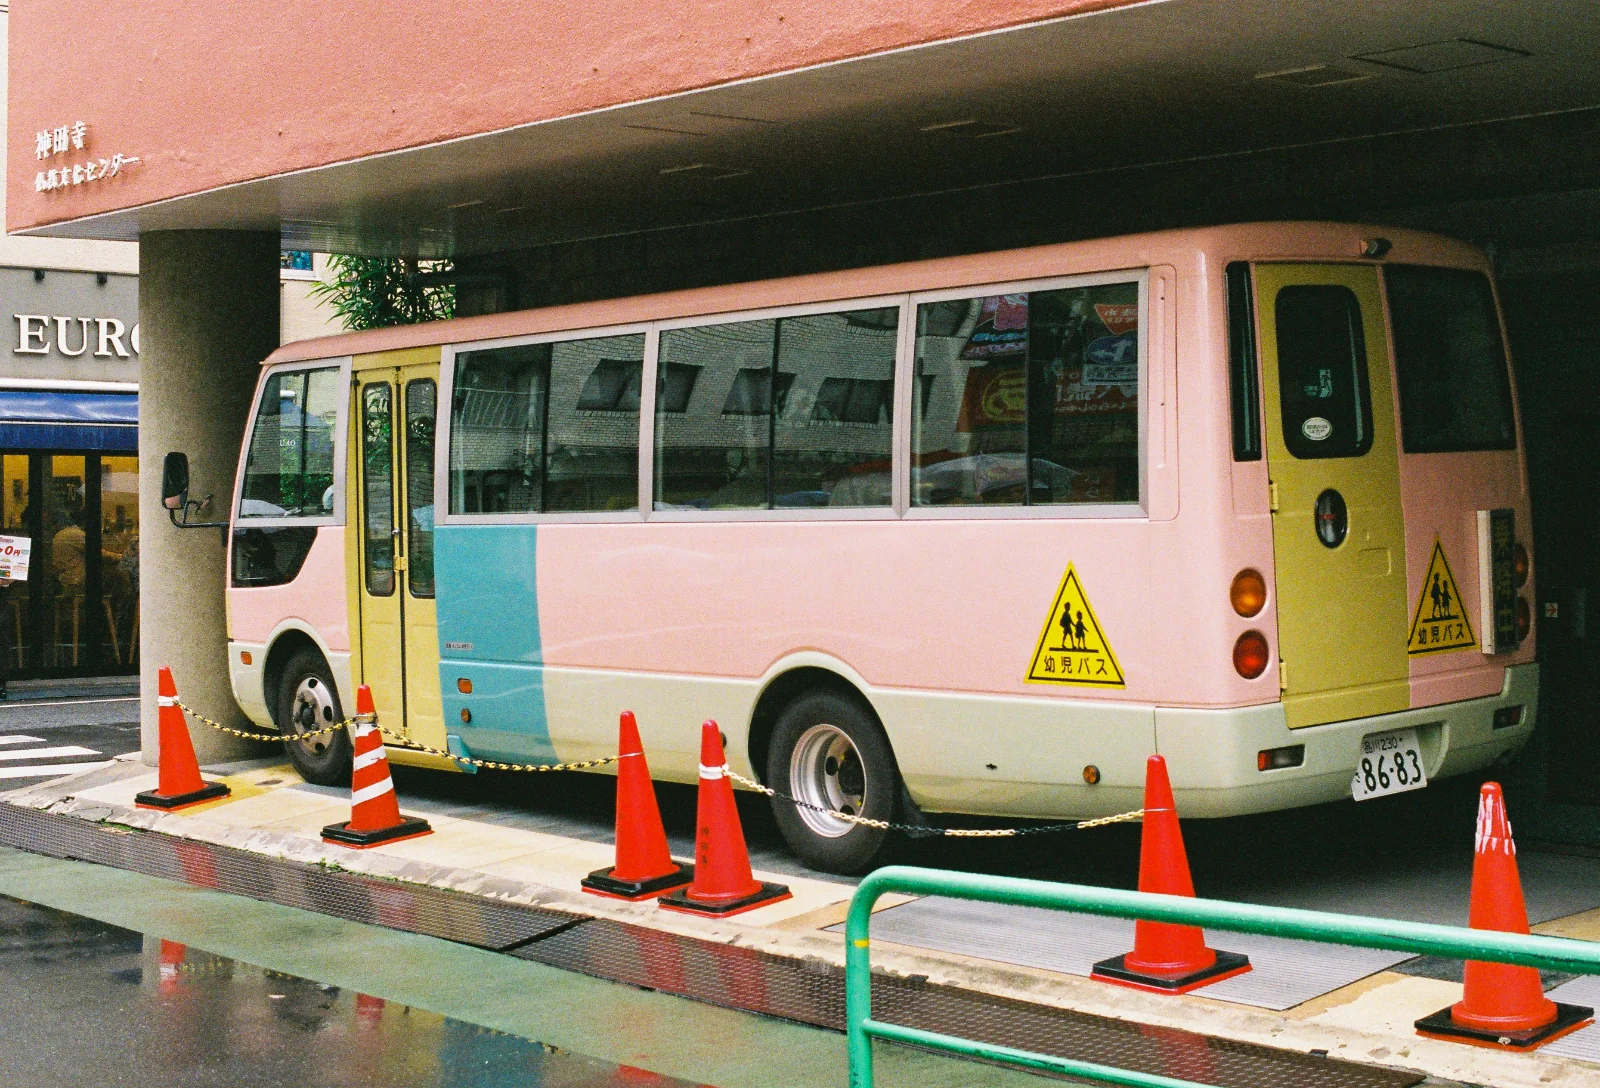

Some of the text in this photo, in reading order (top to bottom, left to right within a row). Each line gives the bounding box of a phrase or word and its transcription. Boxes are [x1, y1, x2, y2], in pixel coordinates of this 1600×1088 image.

[35, 120, 87, 160] 神田寺
[1418, 622, 1465, 645] 幼児バス
[1044, 655, 1108, 676] 幼児バス
